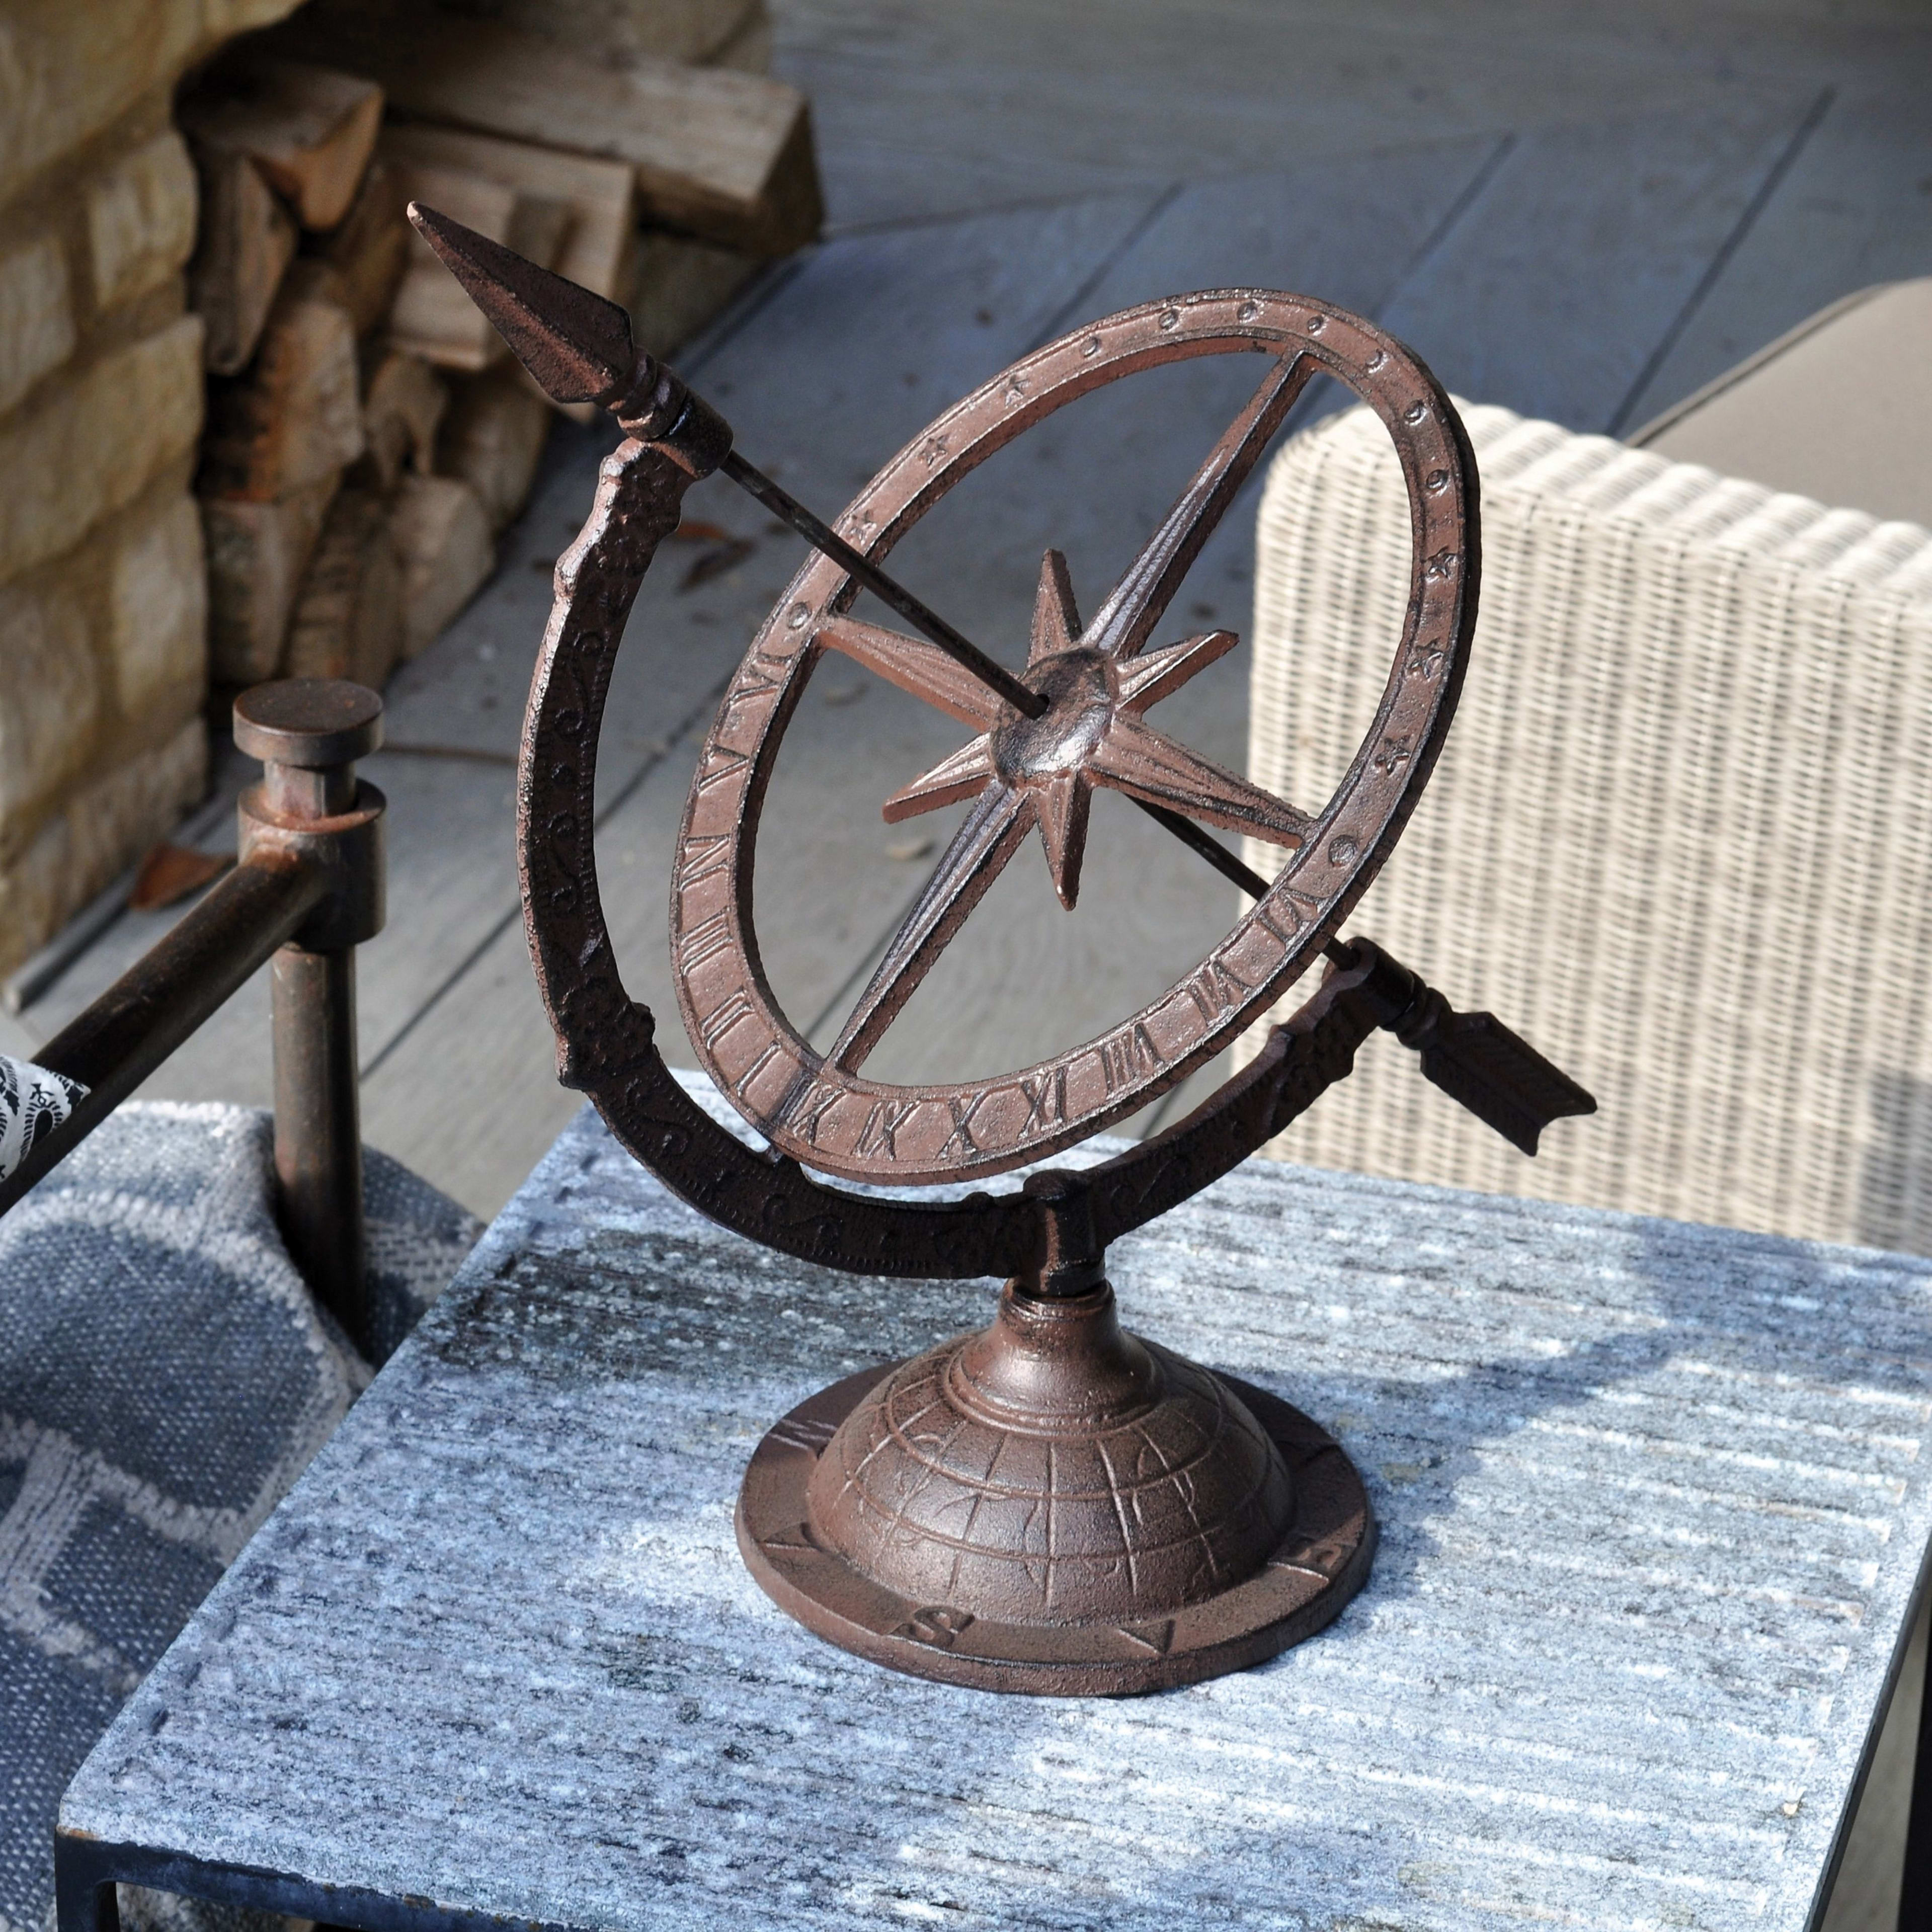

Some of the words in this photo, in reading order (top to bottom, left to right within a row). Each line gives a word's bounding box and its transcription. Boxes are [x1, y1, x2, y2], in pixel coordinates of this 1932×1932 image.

[698, 746, 748, 791] V
[680, 907, 733, 976] III
[700, 986, 754, 1049] II
[938, 1093, 987, 1160] X
[890, 1606, 976, 1647] S
